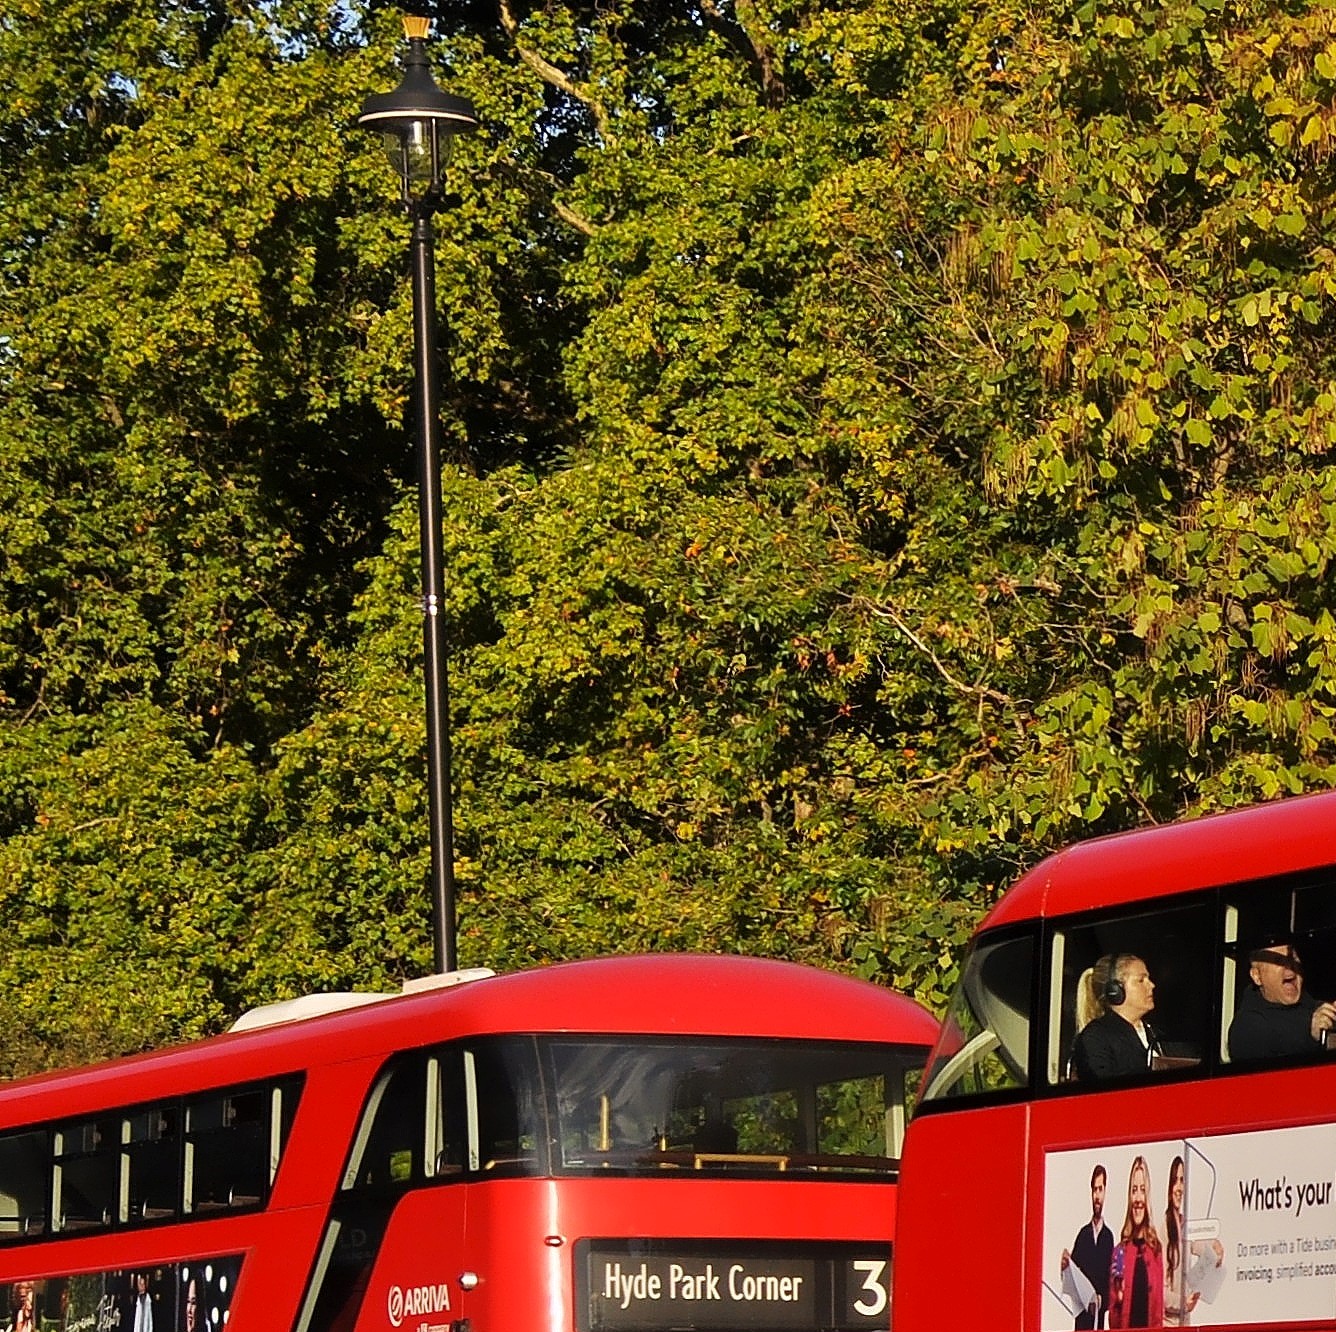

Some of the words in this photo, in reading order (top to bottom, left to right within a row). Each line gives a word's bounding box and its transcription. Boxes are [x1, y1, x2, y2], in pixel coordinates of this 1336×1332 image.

[1239, 1175, 1292, 1211] What's
[1296, 1181, 1332, 1217] your
[605, 1263, 661, 1309] Hyde
[670, 1264, 721, 1300] Park
[728, 1265, 803, 1302] Corner
[853, 1260, 891, 1317] 3
[1276, 1261, 1313, 1281] simplified
[403, 1284, 450, 1317] ARRIVA
